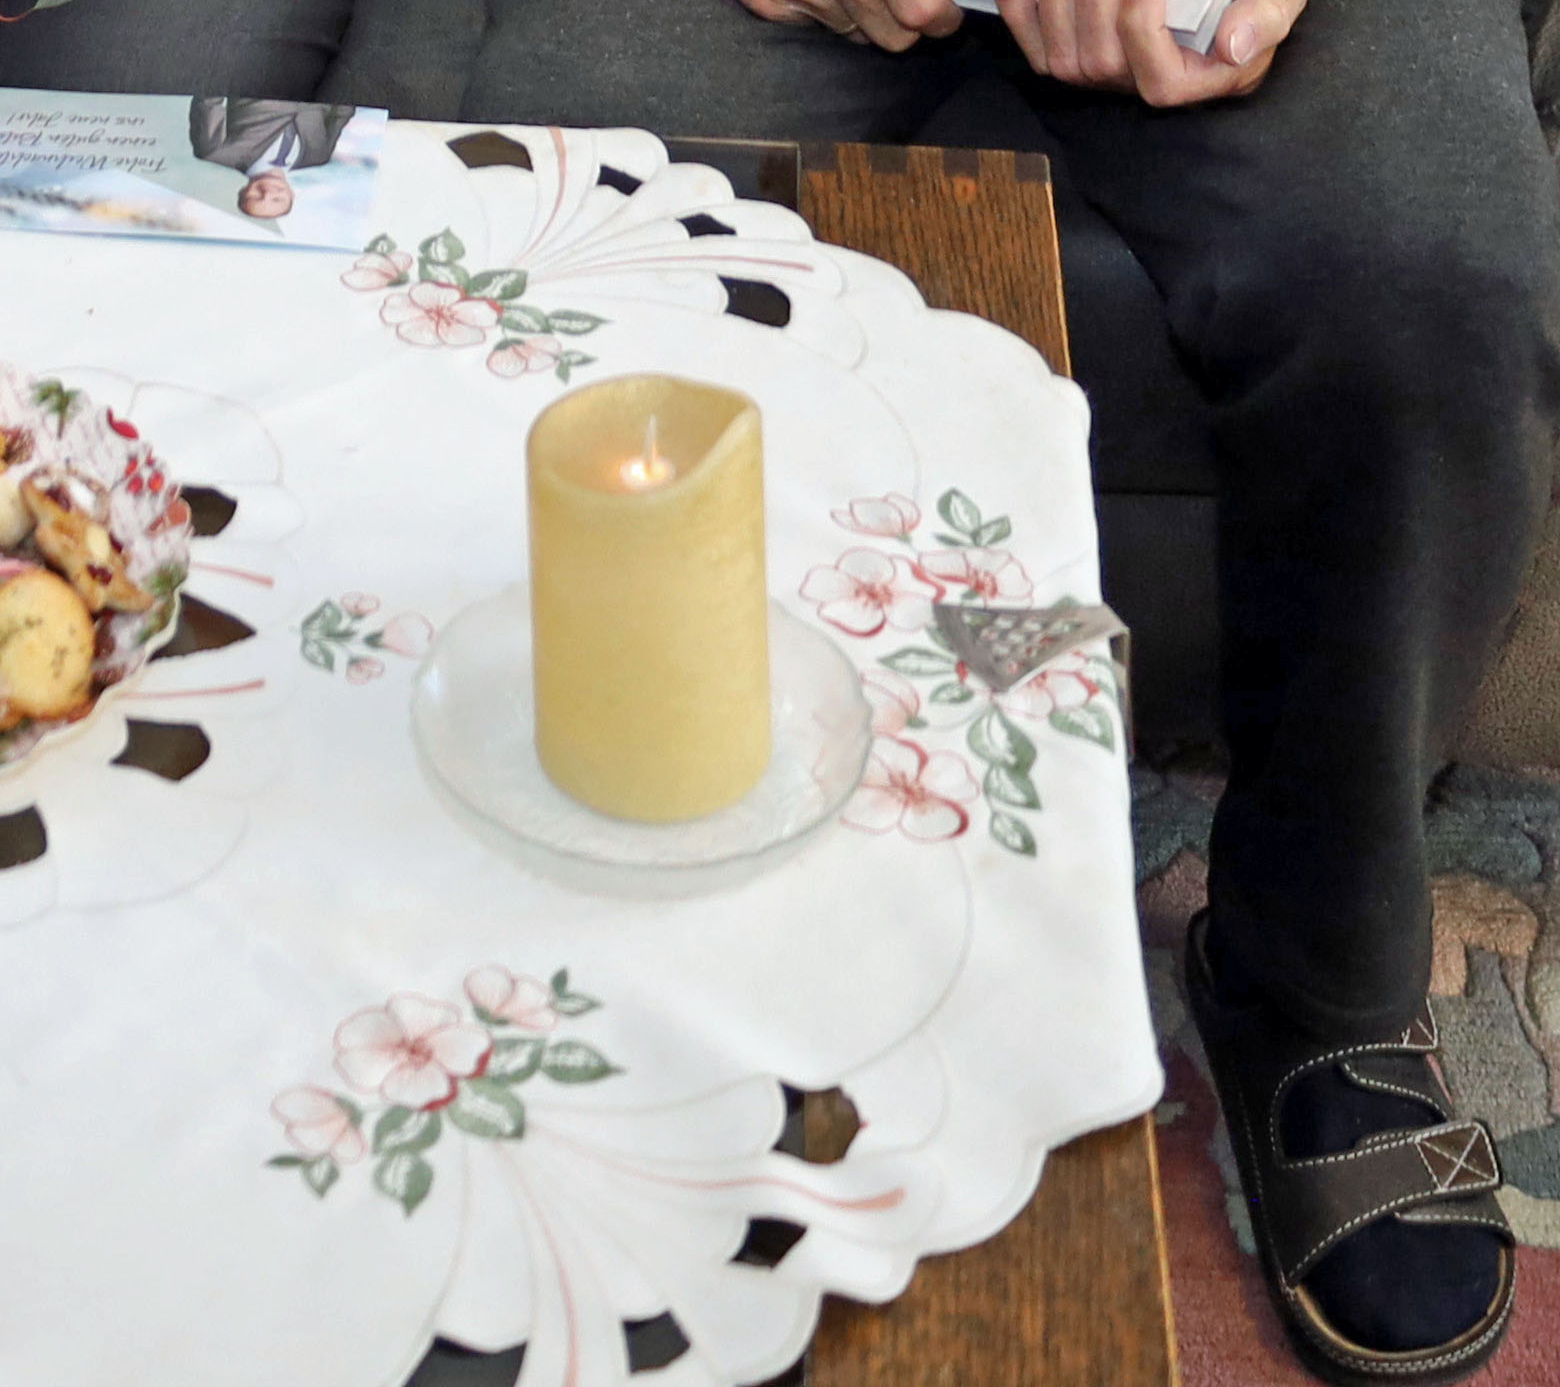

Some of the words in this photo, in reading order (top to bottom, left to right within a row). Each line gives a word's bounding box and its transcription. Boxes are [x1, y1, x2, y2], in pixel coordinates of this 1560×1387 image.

[7, 111, 64, 129] Jahr!
[68, 115, 111, 126] neue
[113, 115, 146, 127] ins
[49, 128, 105, 148] guten
[106, 136, 159, 147] einen
